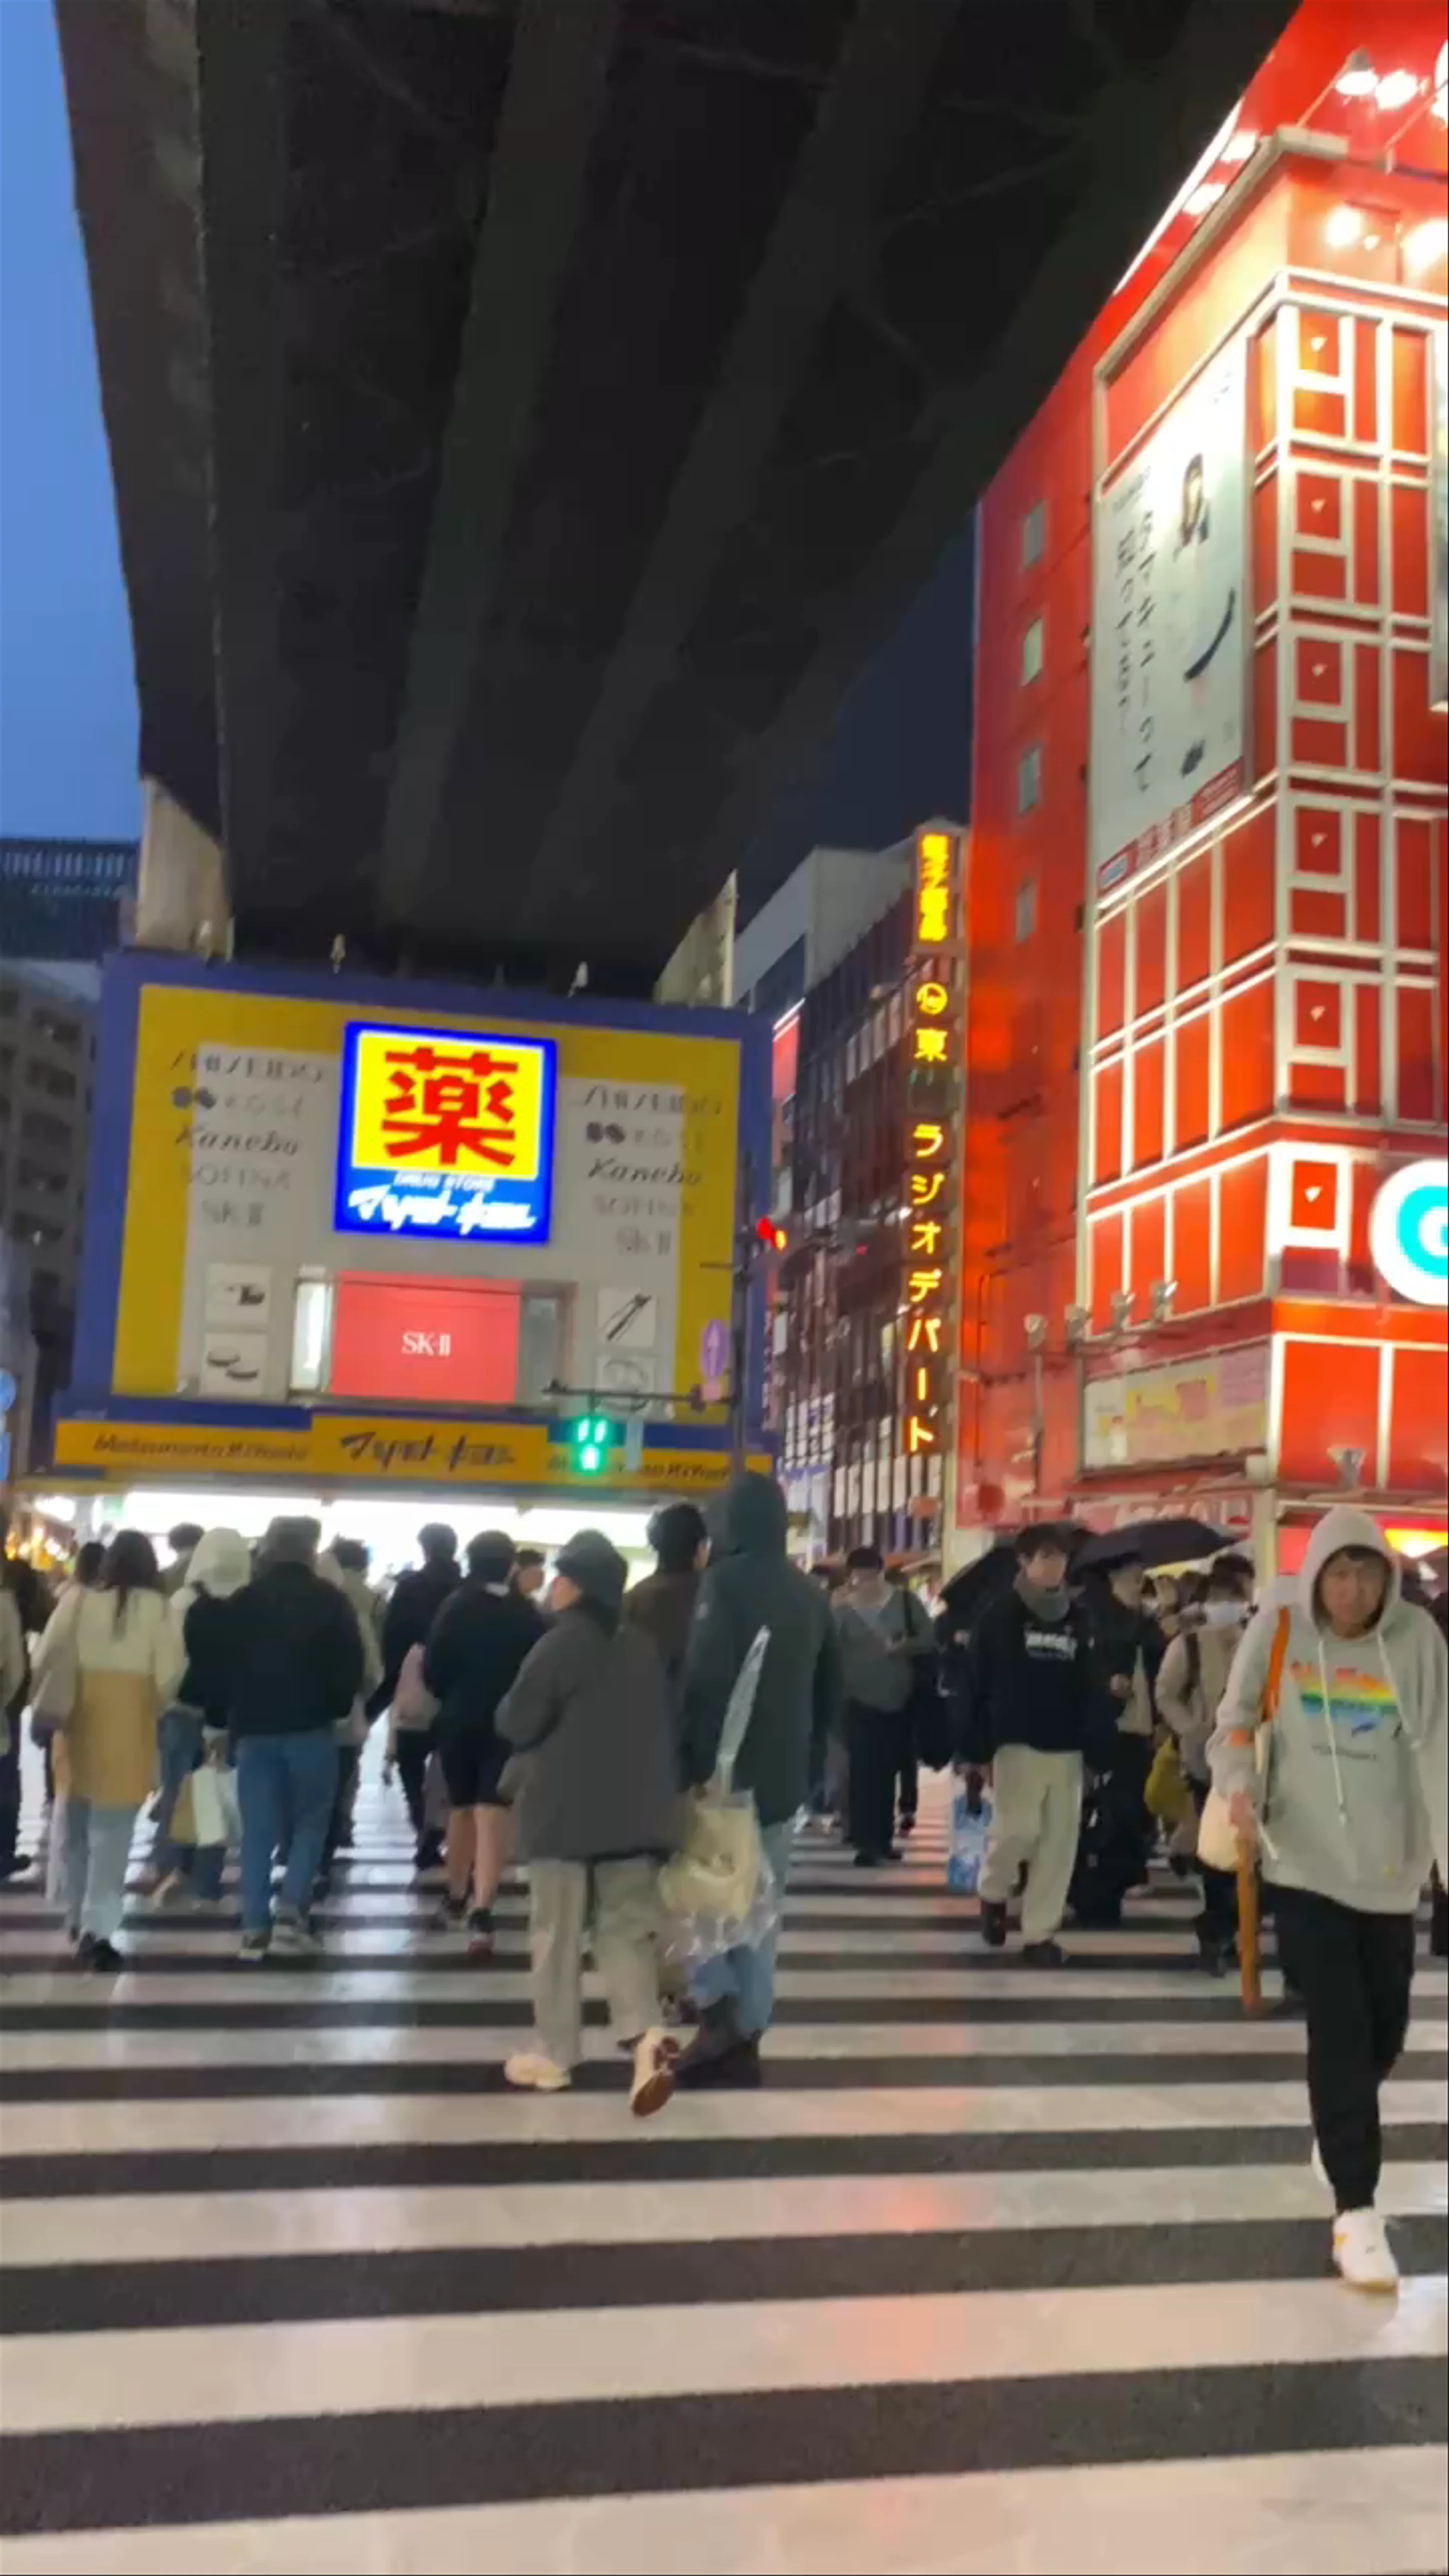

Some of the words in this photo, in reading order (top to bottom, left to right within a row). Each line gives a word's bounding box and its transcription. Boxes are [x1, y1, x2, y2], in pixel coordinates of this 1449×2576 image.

[380, 1047, 518, 1167] 薬
[174, 1124, 299, 1156] Kanebo
[588, 1157, 703, 1186] Kanebo
